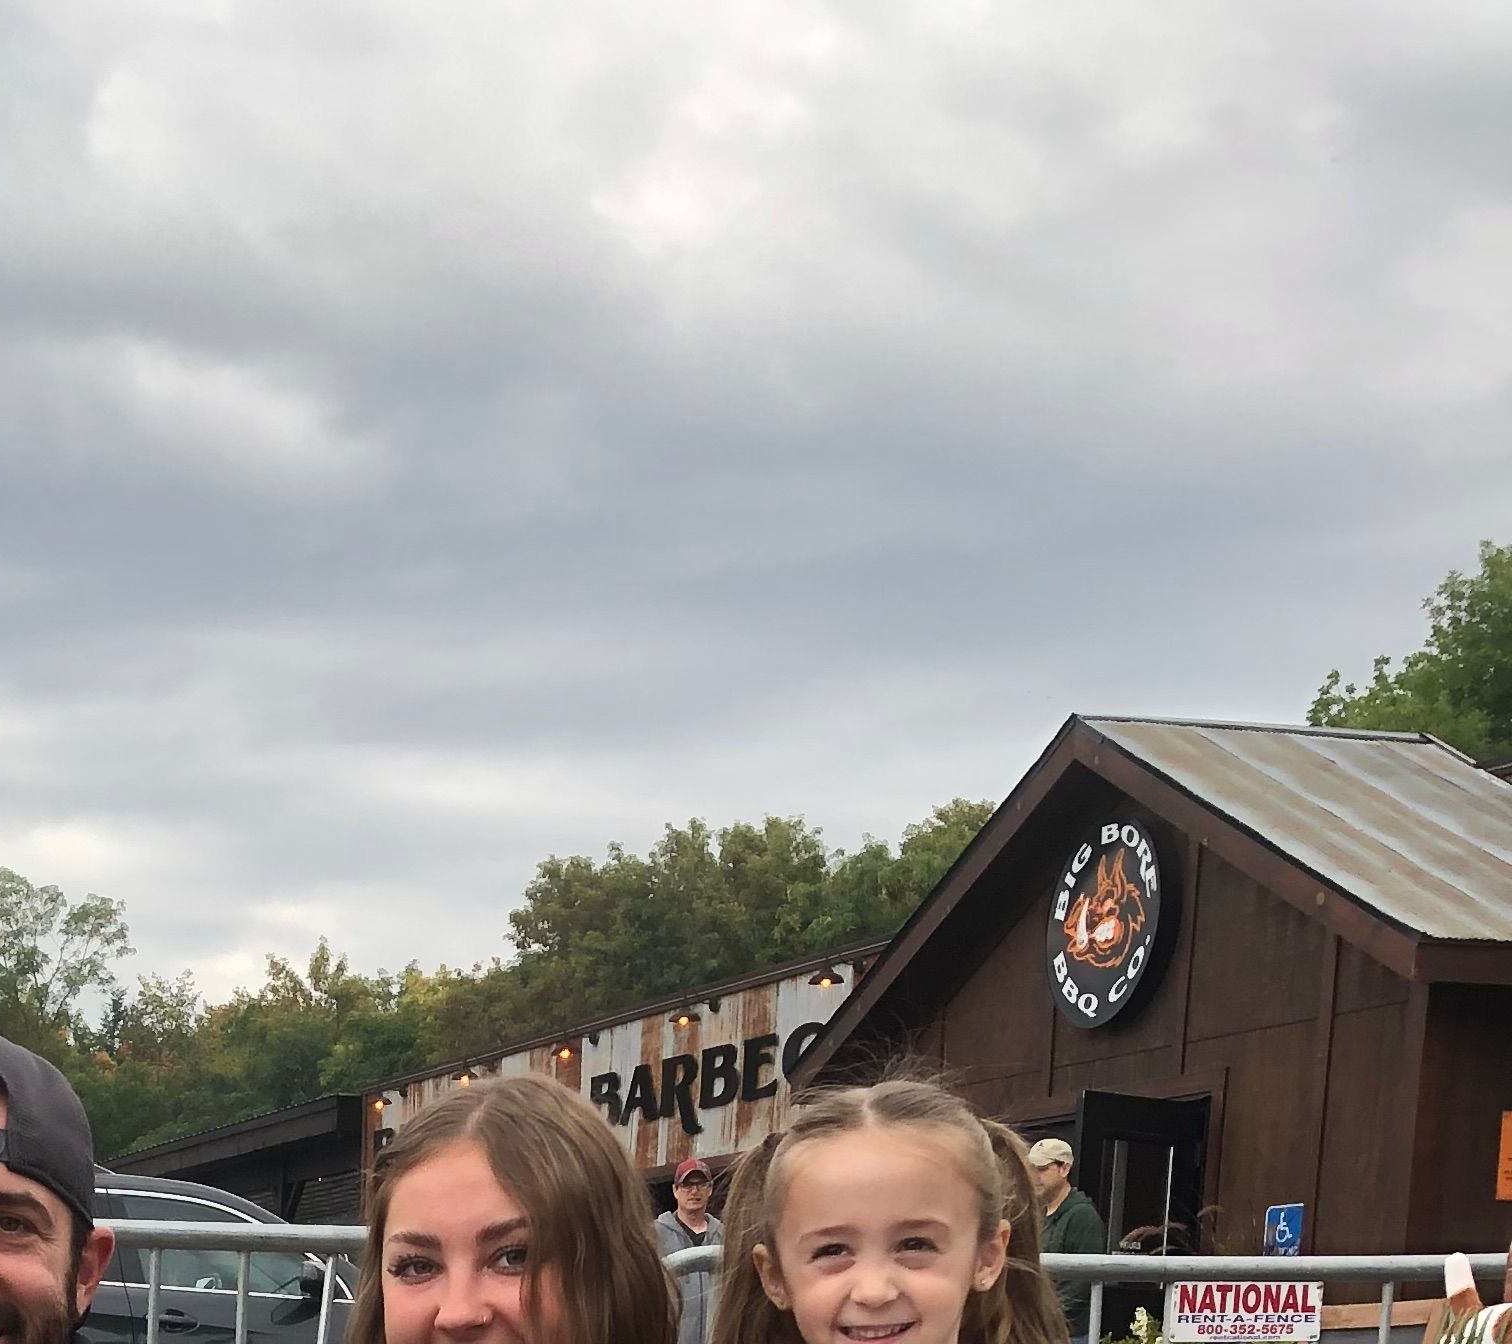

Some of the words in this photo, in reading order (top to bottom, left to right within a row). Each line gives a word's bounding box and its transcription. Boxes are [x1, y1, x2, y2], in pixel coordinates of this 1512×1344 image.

[1054, 843, 1093, 922] BIG
[1101, 822, 1157, 898] BORE
[1053, 951, 1098, 1018] BBQ
[1178, 1284, 1316, 1314] NATIONAL
[1177, 1314, 1316, 1324] RENT-A-FENCE
[1197, 1324, 1294, 1335] 800-352-5675
